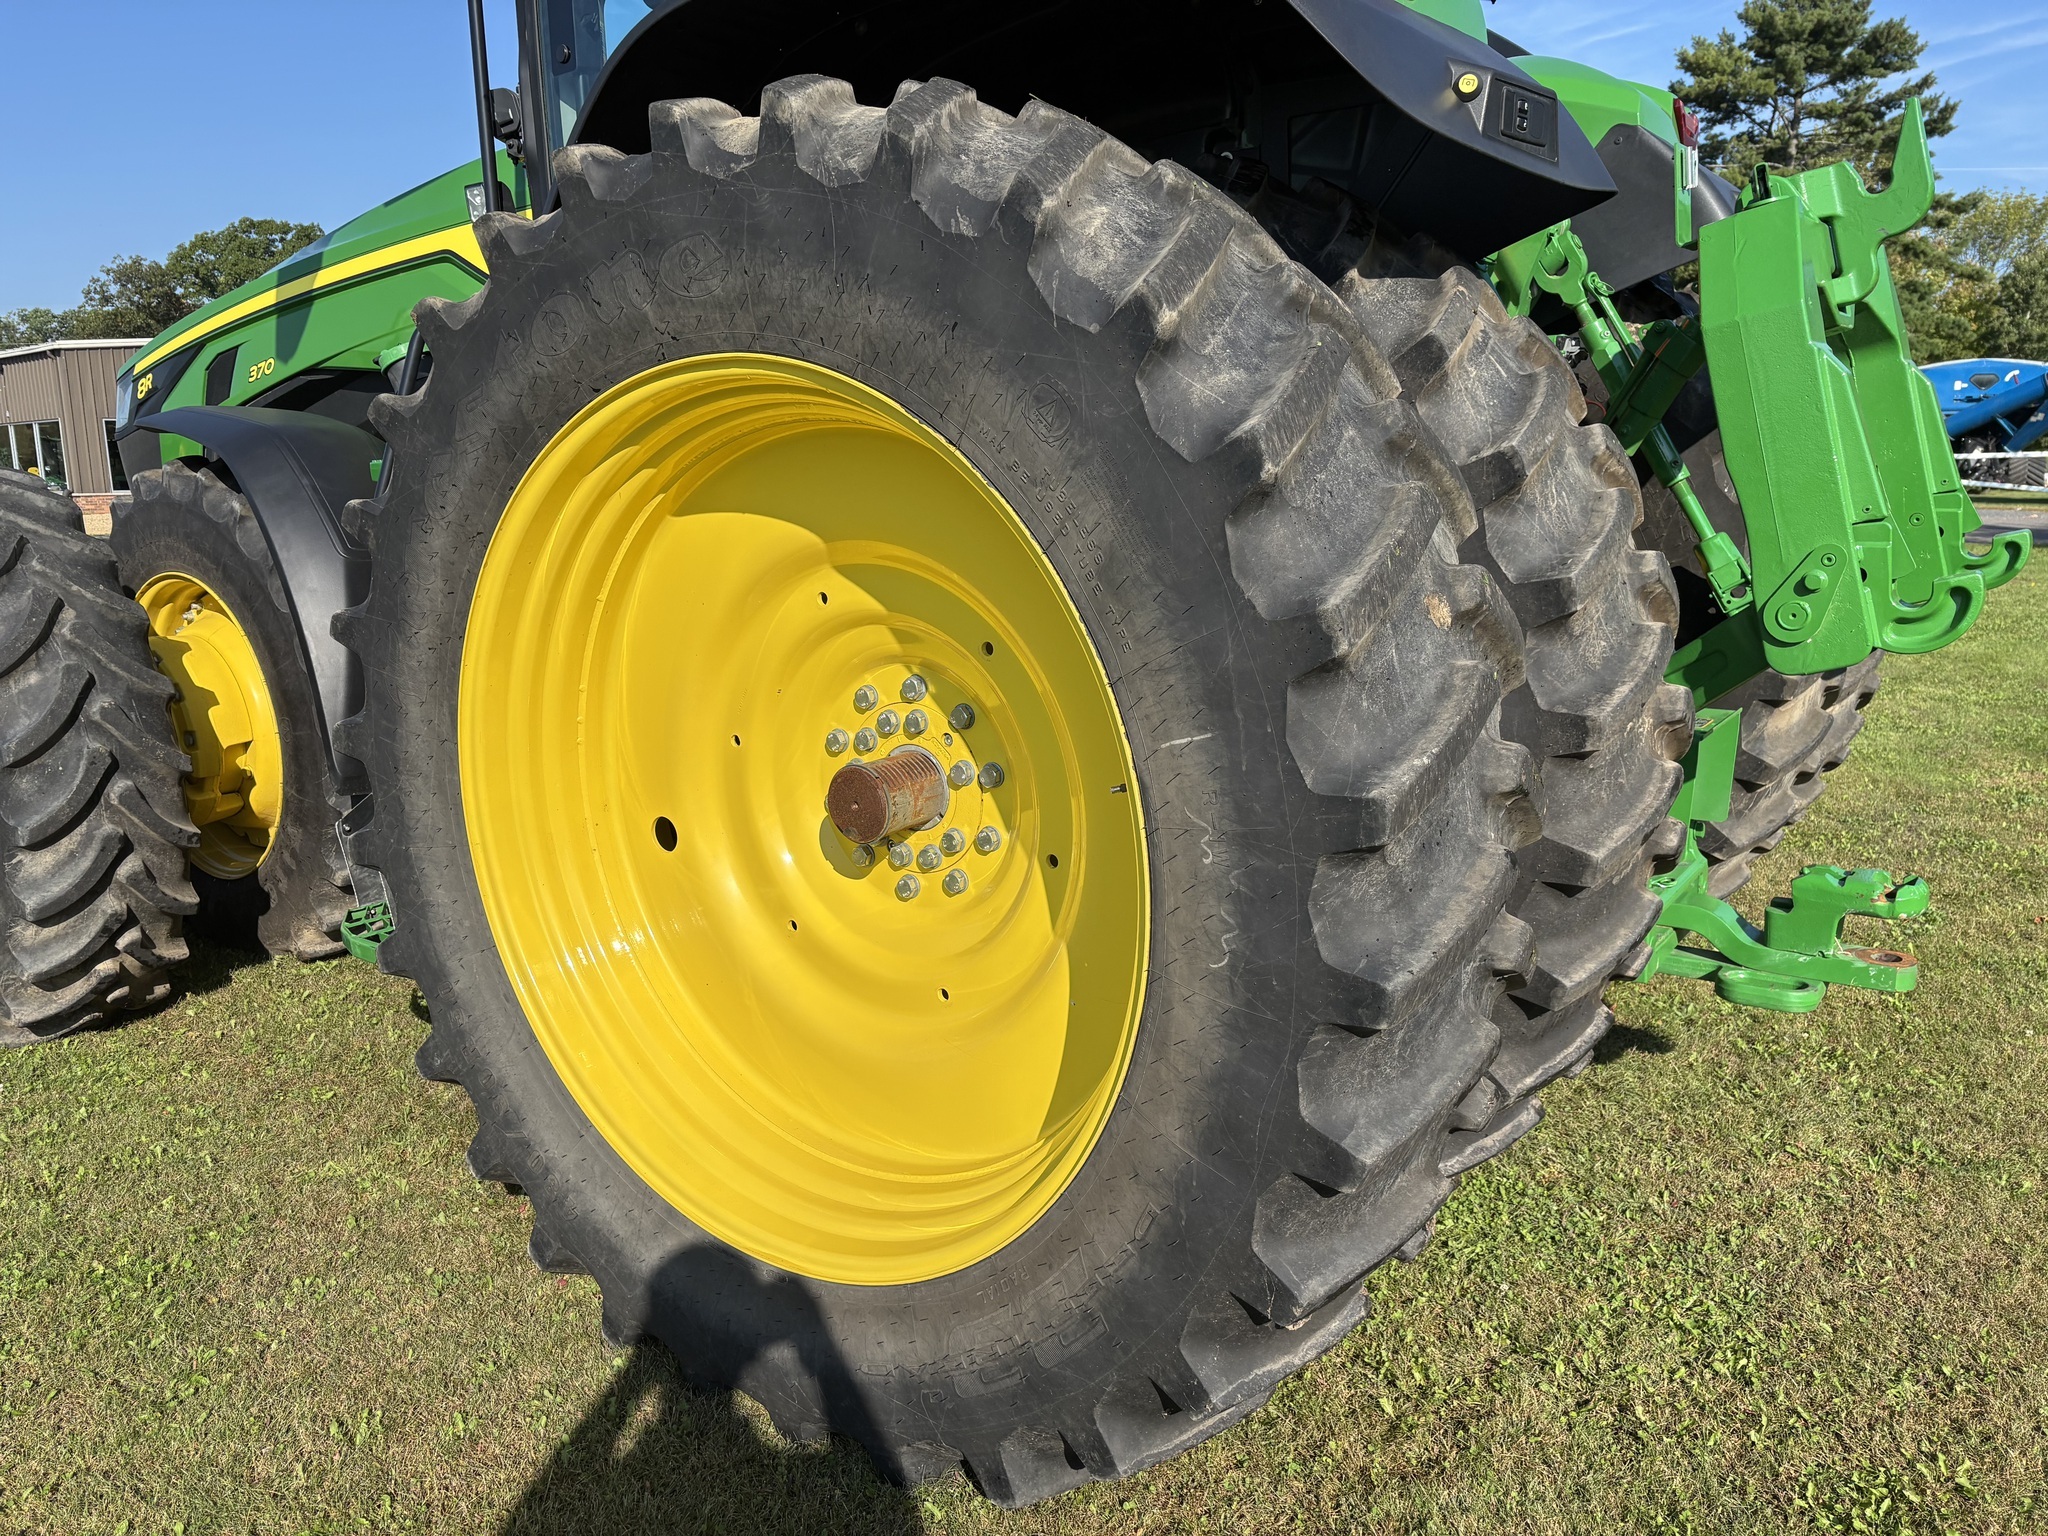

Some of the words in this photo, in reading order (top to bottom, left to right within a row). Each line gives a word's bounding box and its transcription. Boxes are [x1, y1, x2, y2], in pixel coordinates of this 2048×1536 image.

[137, 373, 153, 400] 8R
[248, 357, 275, 383] 370
[1039, 467, 1105, 566] TUBELESS
[1010, 459, 1029, 485] BE
[1034, 487, 1070, 538] USED
[1071, 545, 1104, 597] TUBE
[1104, 604, 1134, 655] TYPE
[977, 1262, 1031, 1306] RADIAL
